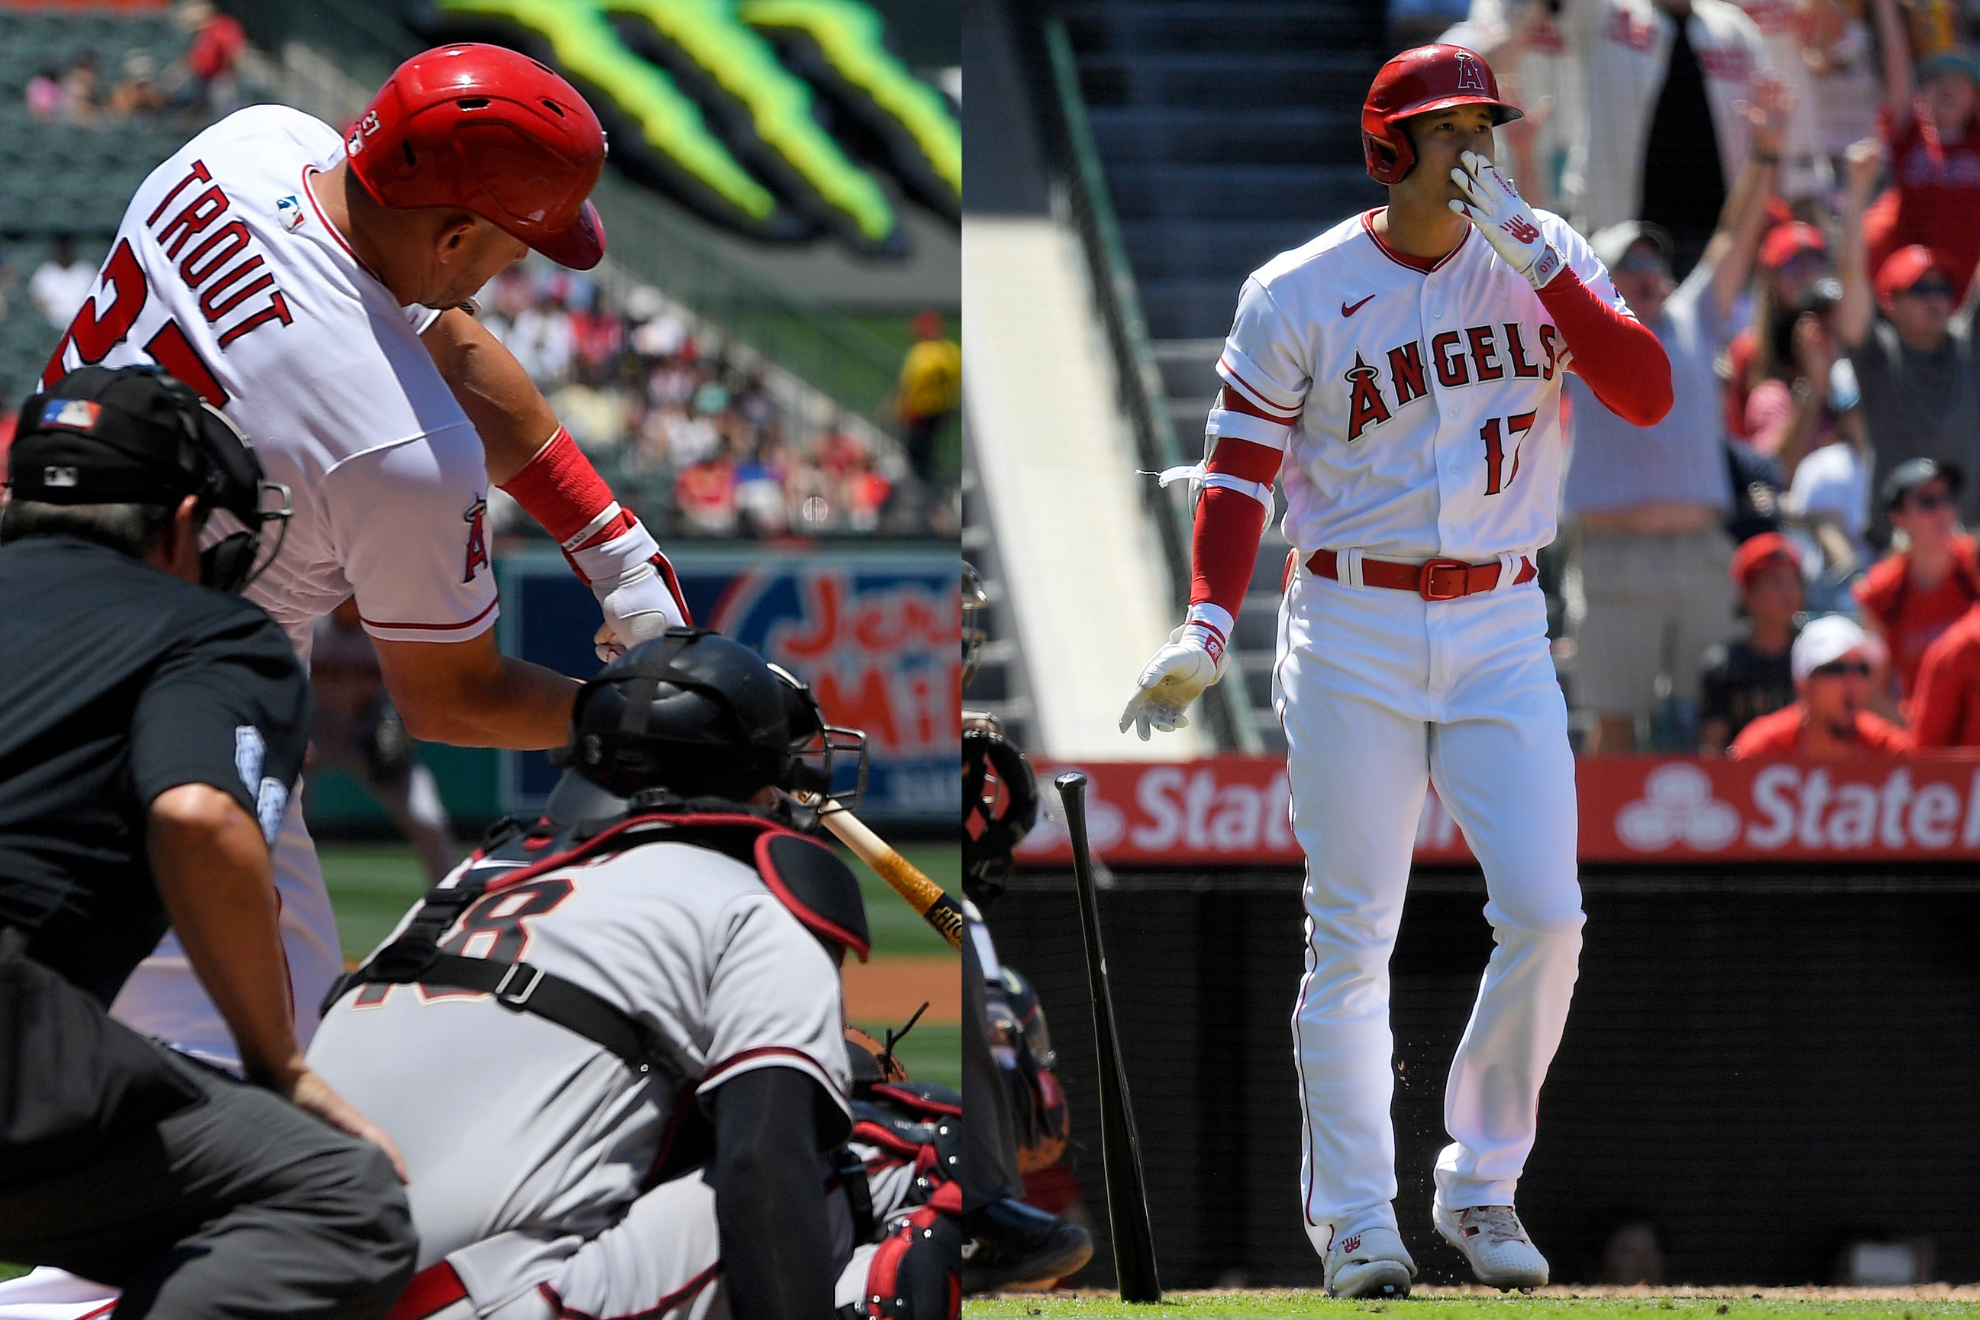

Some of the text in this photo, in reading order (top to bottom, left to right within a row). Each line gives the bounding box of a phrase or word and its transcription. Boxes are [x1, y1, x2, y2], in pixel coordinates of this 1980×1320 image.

[362, 110, 381, 136] 27
[146, 159, 294, 351] TROUT
[1539, 256, 1556, 273] 017
[1344, 322, 1557, 443] ANGELS
[1479, 407, 1538, 496] 17
[1131, 764, 1298, 853] Stat
[350, 877, 578, 1011] 8
